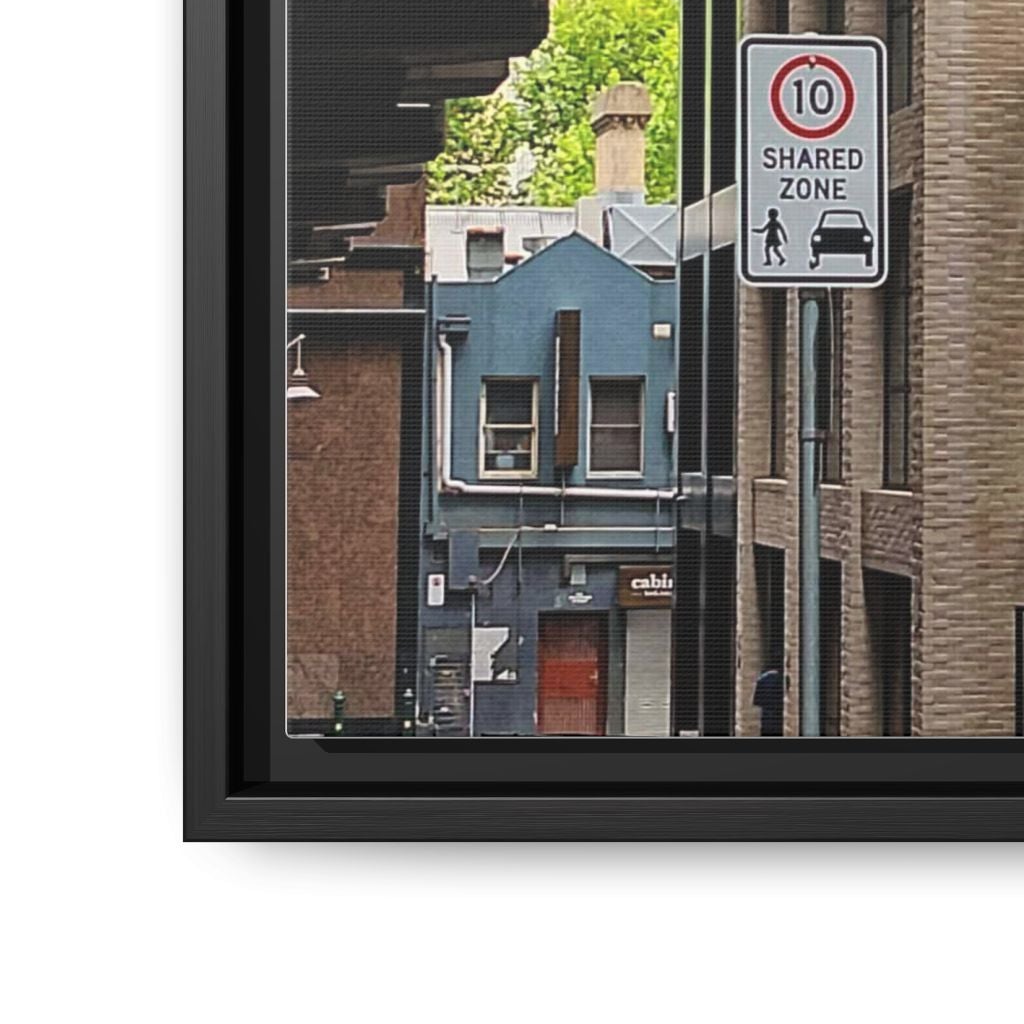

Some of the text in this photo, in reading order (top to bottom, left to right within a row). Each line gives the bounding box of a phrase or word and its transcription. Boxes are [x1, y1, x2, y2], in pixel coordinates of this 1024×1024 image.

[793, 79, 835, 115] 10
[763, 147, 863, 170] SHARED
[780, 178, 847, 200] ZONE
